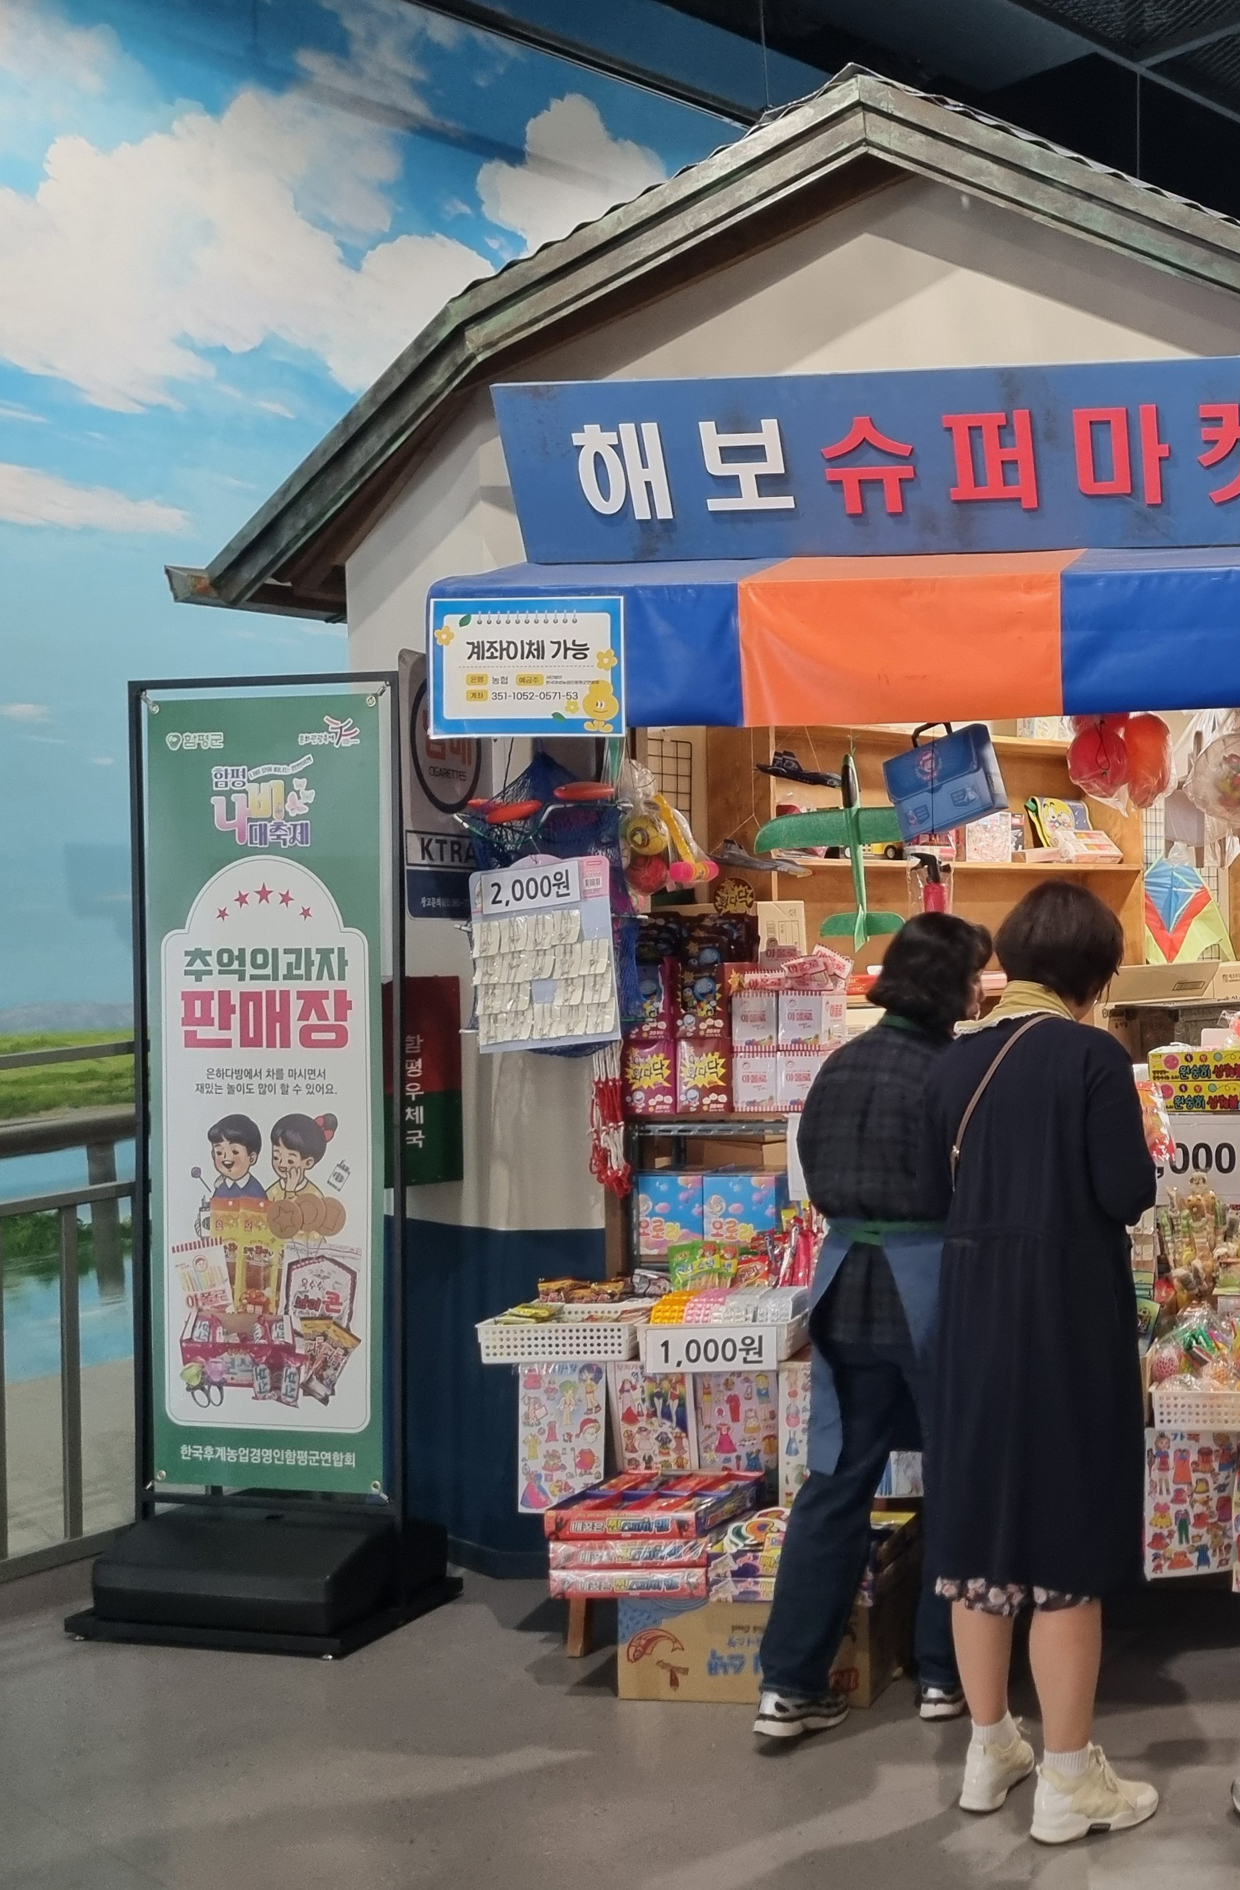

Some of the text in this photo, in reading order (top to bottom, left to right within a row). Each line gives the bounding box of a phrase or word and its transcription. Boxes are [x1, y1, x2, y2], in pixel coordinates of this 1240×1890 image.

[465, 639, 591, 661] 계좌이체 가능
[492, 676, 509, 685] 농협
[490, 691, 579, 701] 351-1052-0571-53
[183, 733, 225, 749] 함평군
[213, 768, 247, 789] 함평
[428, 766, 467, 781] CIGARETTES
[248, 820, 311, 847] 대축제
[490, 869, 572, 908] 2,000원
[181, 990, 353, 1049] 판매장
[206, 1067, 326, 1080] 은하다방에서 차를 마시면서
[195, 1083, 338, 1096] 재밌는 놀이도 많이 할 수 있어요.
[1157, 1141, 1237, 1178] ,000
[660, 1334, 764, 1368] 1,000원
[180, 1444, 356, 1468] 한국후계농업경영인함평군연합회
